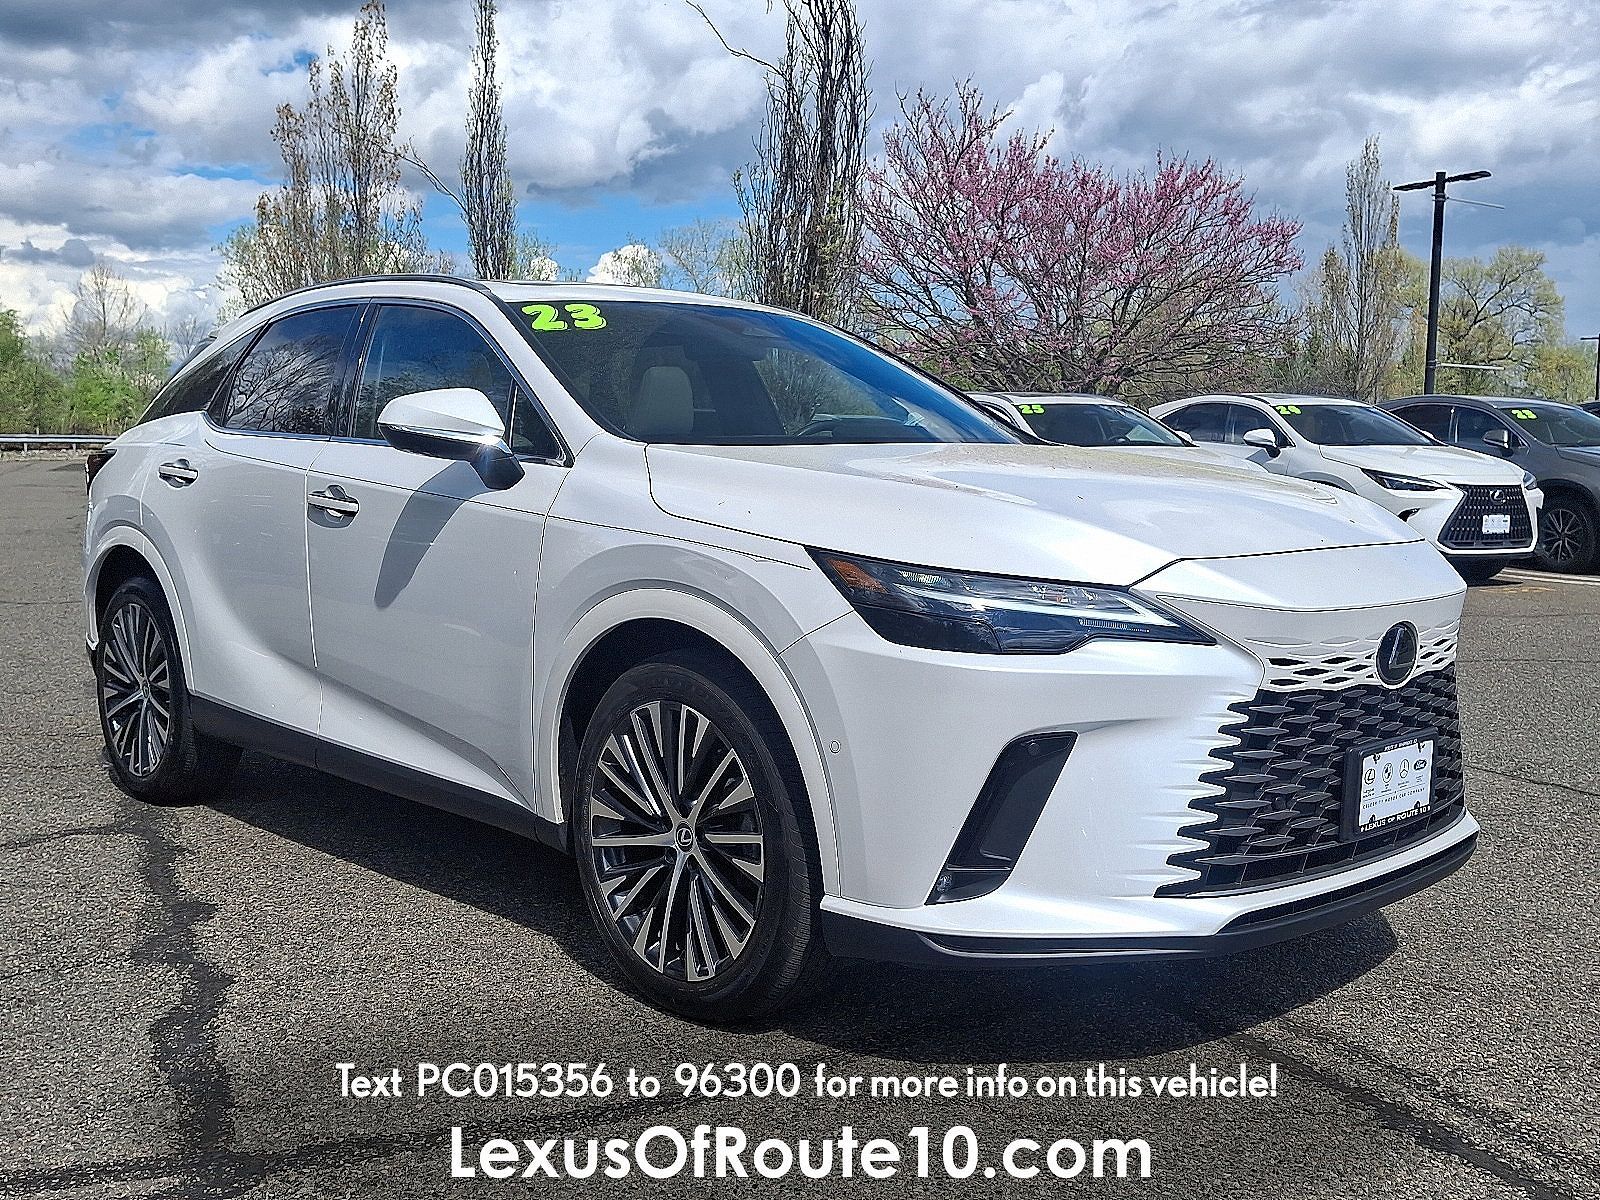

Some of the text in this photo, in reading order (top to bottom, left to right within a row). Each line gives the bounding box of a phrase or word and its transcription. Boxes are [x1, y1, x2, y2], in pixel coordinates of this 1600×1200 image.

[521, 303, 606, 331] 23
[1018, 404, 1045, 414] 25
[1364, 819, 1386, 831] LEXUS
[1396, 808, 1419, 821] ROUTE
[1419, 806, 1427, 814] 10
